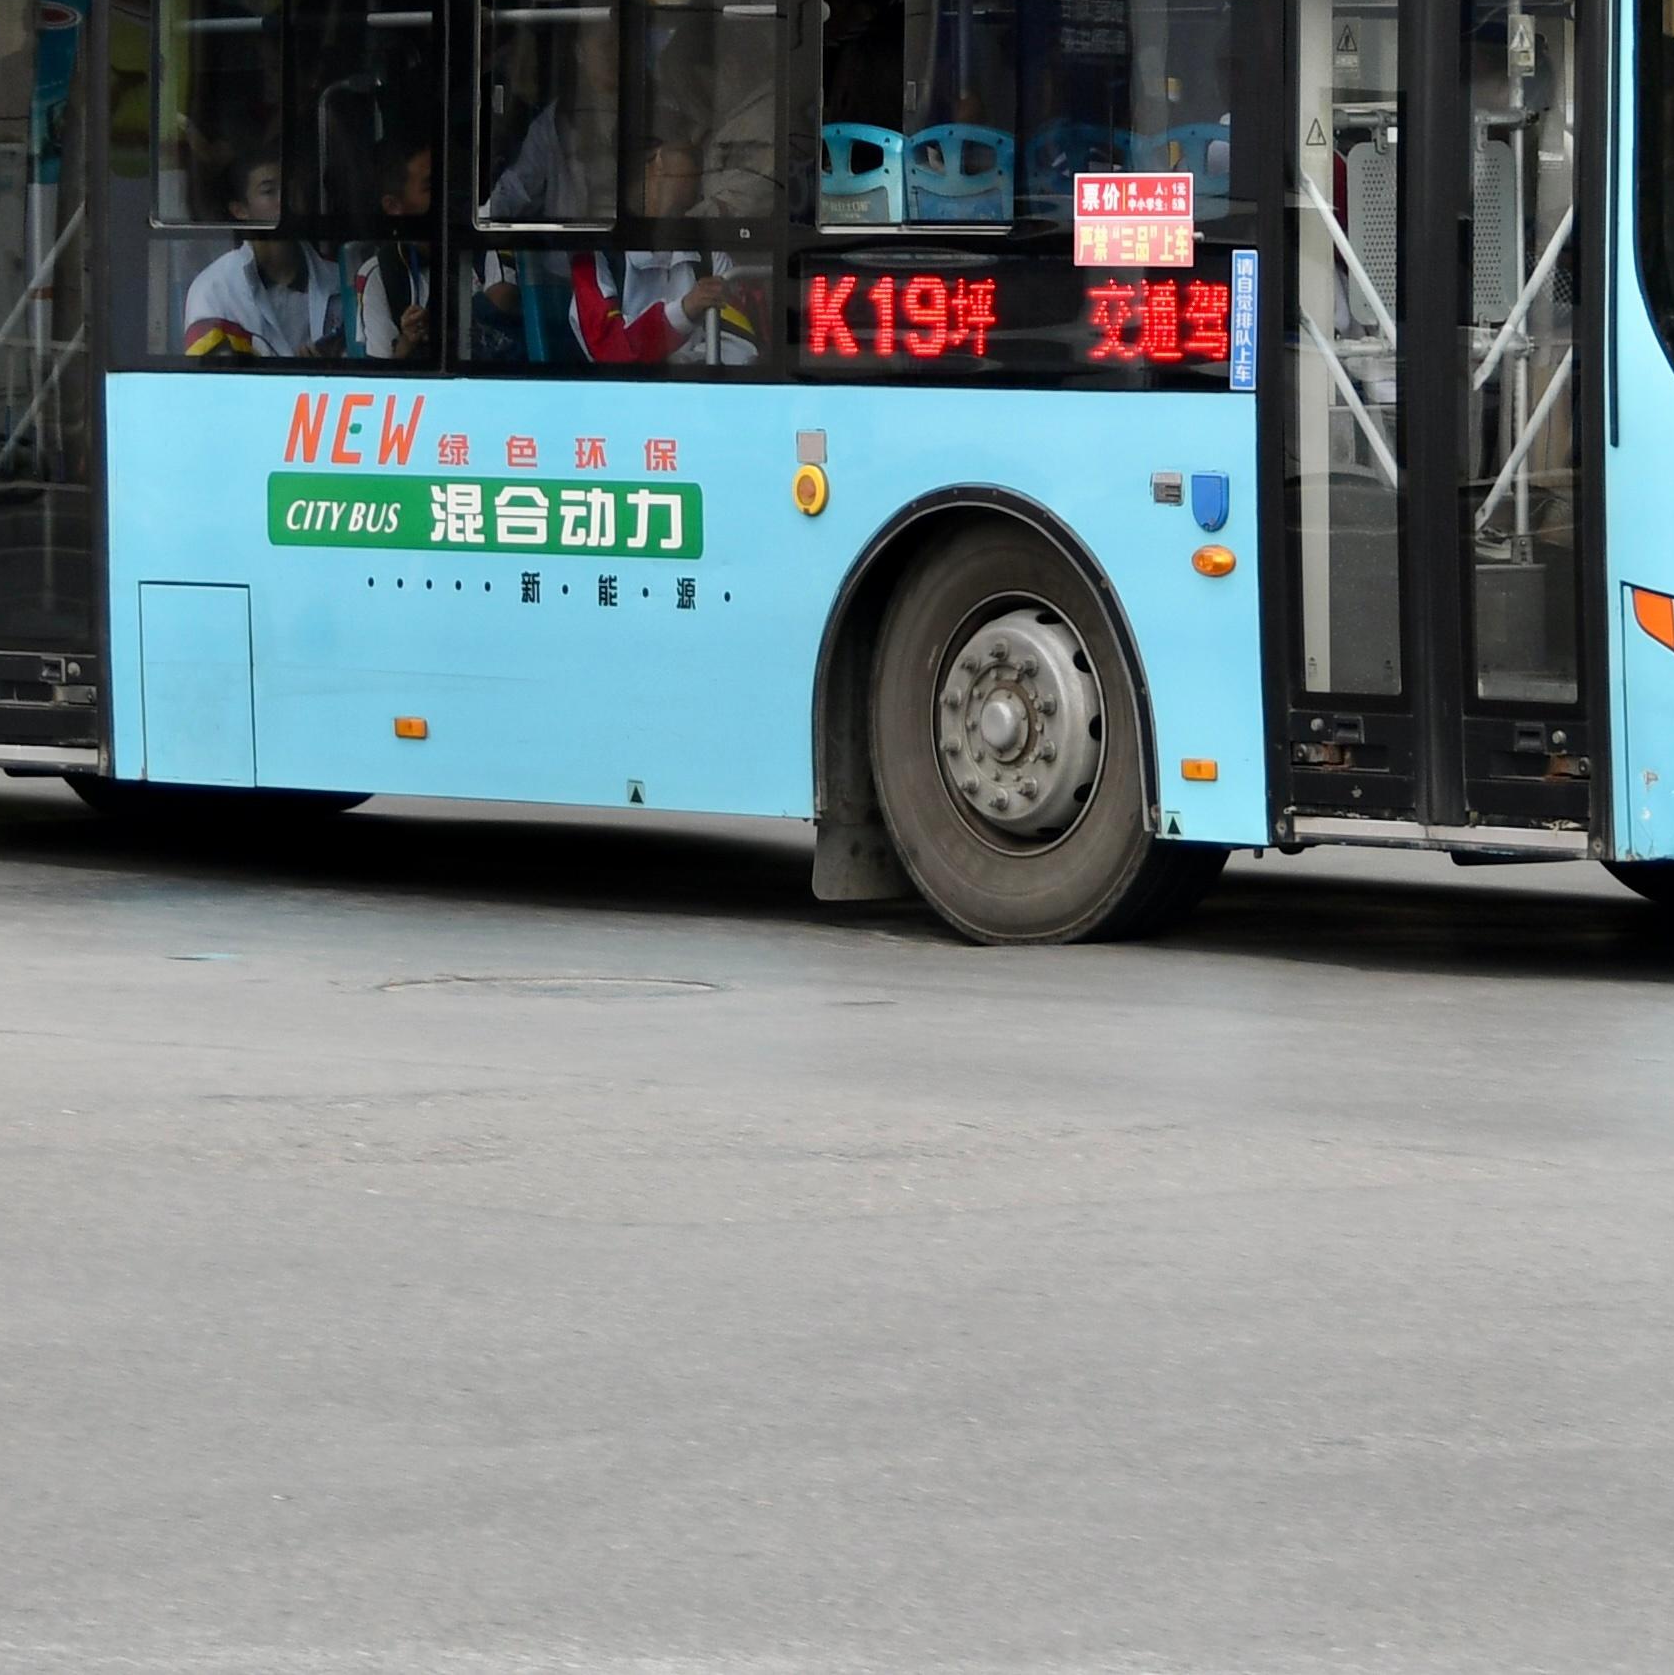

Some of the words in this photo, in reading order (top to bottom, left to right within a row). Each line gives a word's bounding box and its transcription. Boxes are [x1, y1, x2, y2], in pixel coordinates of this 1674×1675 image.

[1081, 182, 1121, 212] 票价
[1234, 257, 1254, 383] 请自觉排队上车
[283, 392, 426, 466] NEW
[437, 433, 679, 472] 绿色环保
[285, 499, 347, 532] CITY
[349, 503, 401, 534] BUS
[429, 483, 684, 551] 混合动力
